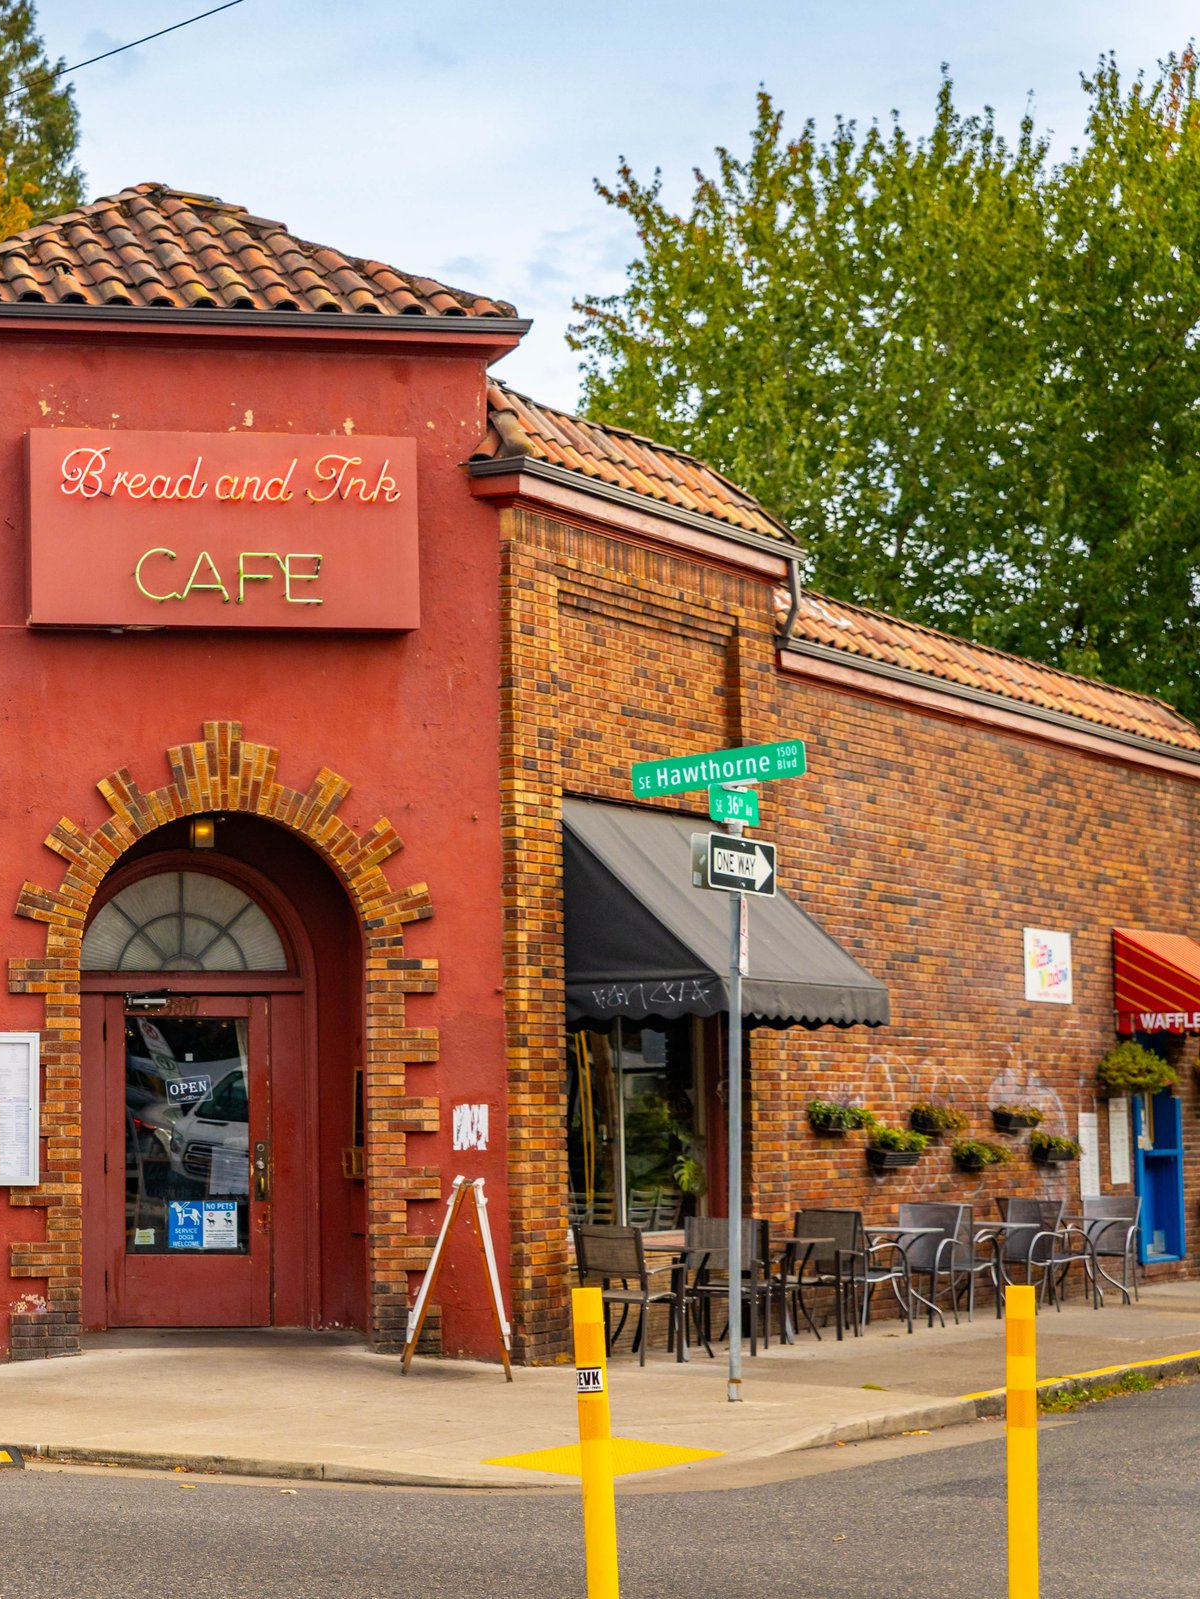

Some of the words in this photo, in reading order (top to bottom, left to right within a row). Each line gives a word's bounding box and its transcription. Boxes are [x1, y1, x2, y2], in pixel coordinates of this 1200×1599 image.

[61, 446, 208, 499] Bread
[215, 456, 298, 503] and
[304, 453, 402, 504] Ink
[134, 547, 323, 605] CAFE
[638, 776, 651, 790] SE
[656, 755, 771, 788] Hawthorne
[776, 745, 798, 758] 1500
[776, 757, 798, 770] Blvd
[715, 799, 723, 813] SE
[716, 851, 734, 873] ONE
[738, 857, 756, 877] WAY
[169, 1079, 208, 1096] OPEN
